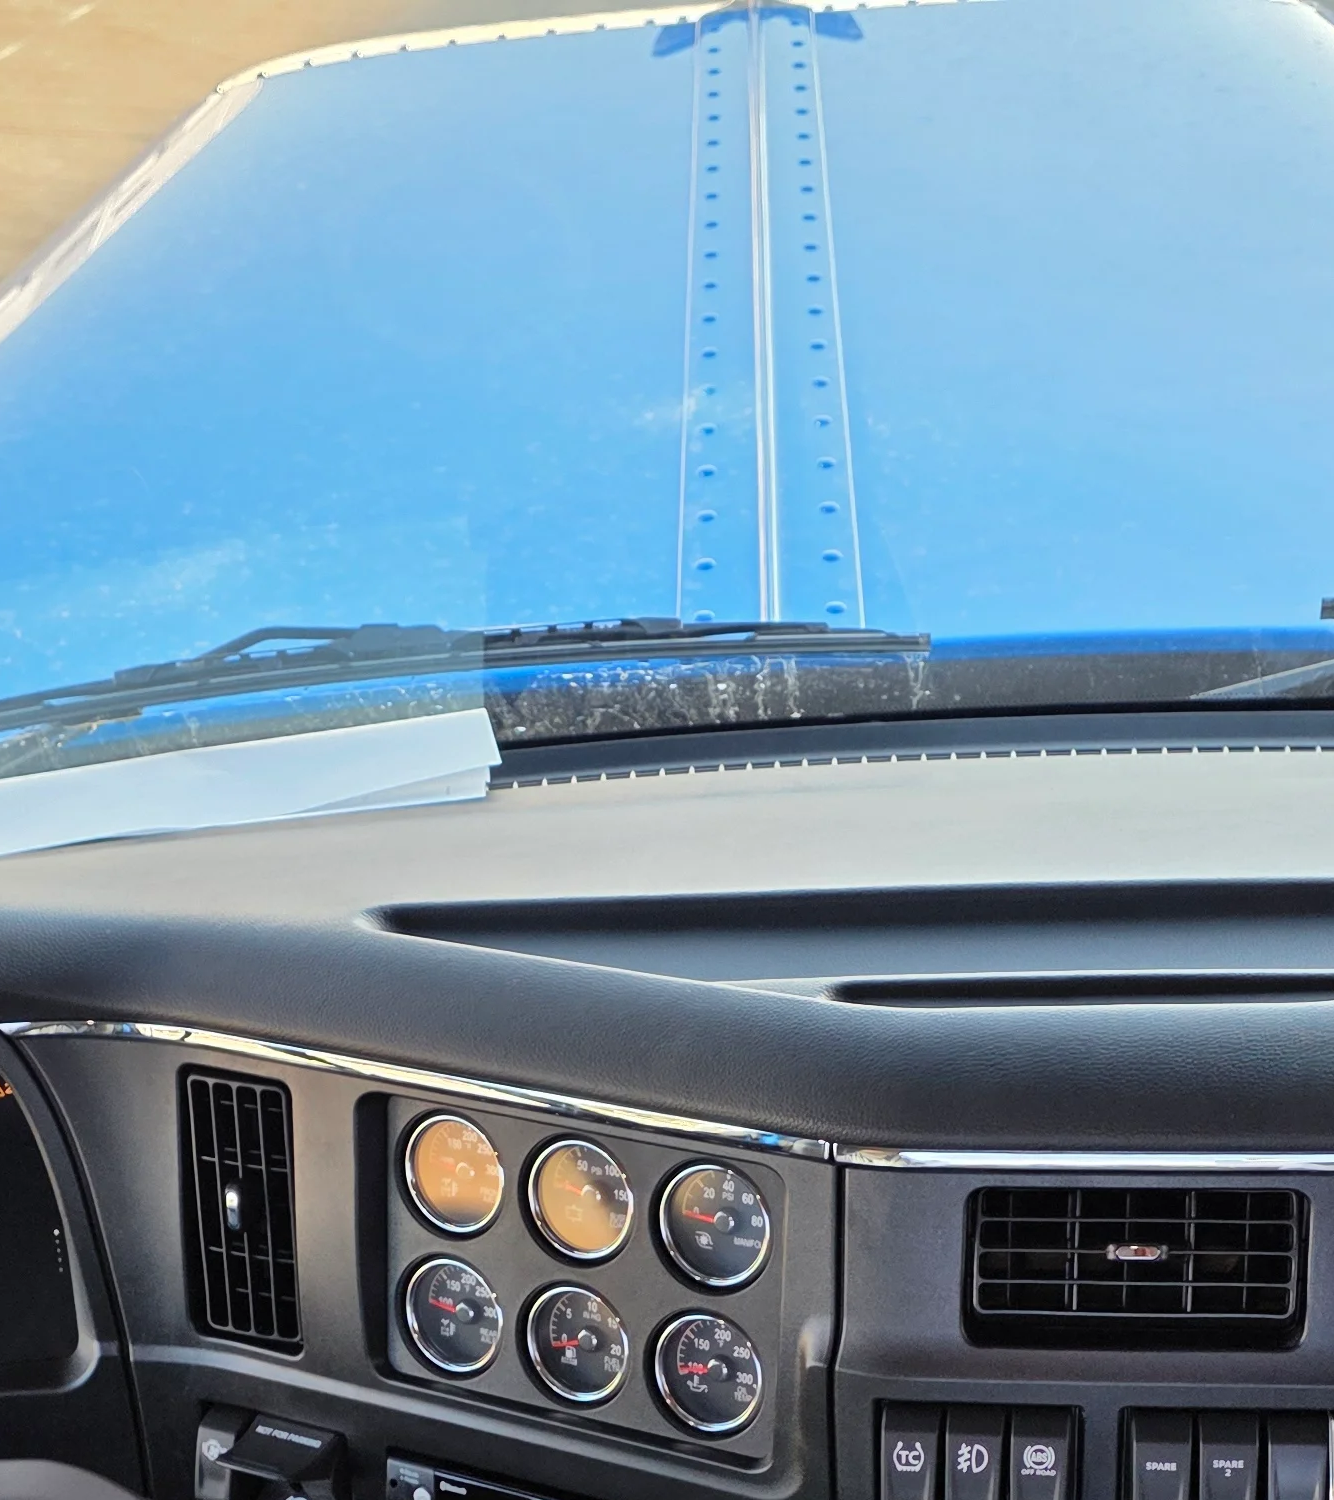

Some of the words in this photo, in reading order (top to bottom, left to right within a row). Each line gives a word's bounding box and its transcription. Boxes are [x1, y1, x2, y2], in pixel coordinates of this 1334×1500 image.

[576, 1159, 588, 1173] 50
[590, 1165, 603, 1176] PSI
[604, 1164, 621, 1178] 100
[722, 1180, 735, 1193] 40
[613, 1188, 629, 1203] 150
[703, 1186, 716, 1200] 20
[721, 1191, 735, 1201] PSI
[741, 1192, 755, 1206] 60
[750, 1215, 763, 1228] 80
[446, 1278, 462, 1293] 150
[460, 1272, 477, 1286] 200
[586, 1300, 599, 1313] 10
[565, 1308, 573, 1320] 5
[607, 1316, 618, 1329] 15
[713, 1328, 732, 1342] 200
[609, 1343, 622, 1355] 20
[693, 1337, 711, 1351] 150
[732, 1346, 751, 1360] 250
[735, 1371, 754, 1385] 300
[898, 1450, 919, 1464] TC
[1030, 1451, 1049, 1463] ABS
[1145, 1460, 1177, 1471] SPARE
[1212, 1459, 1244, 1469] SPARE
[1021, 1468, 1035, 1476] OFF
[1035, 1469, 1057, 1477] ROAD
[1224, 1468, 1232, 1477] 2
